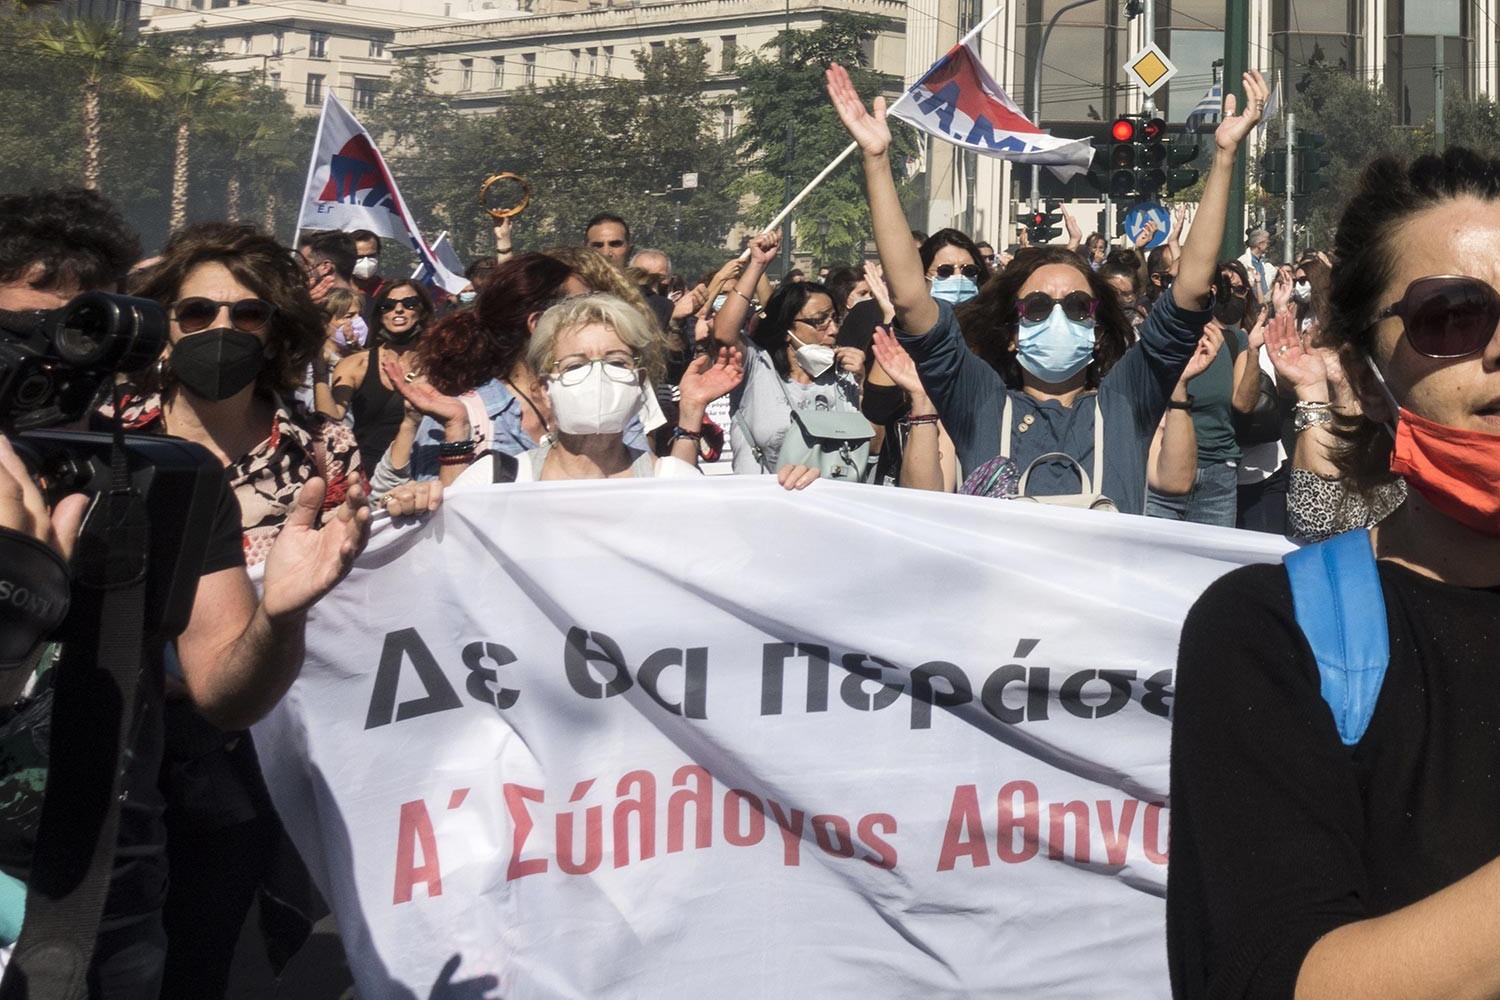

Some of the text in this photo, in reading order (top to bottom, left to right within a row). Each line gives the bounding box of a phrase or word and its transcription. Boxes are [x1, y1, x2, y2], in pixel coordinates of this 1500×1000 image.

[364, 626, 521, 731] Δε
[563, 625, 709, 720] θα
[760, 638, 1175, 730] περάσε
[503, 764, 898, 882] Σύλλογος
